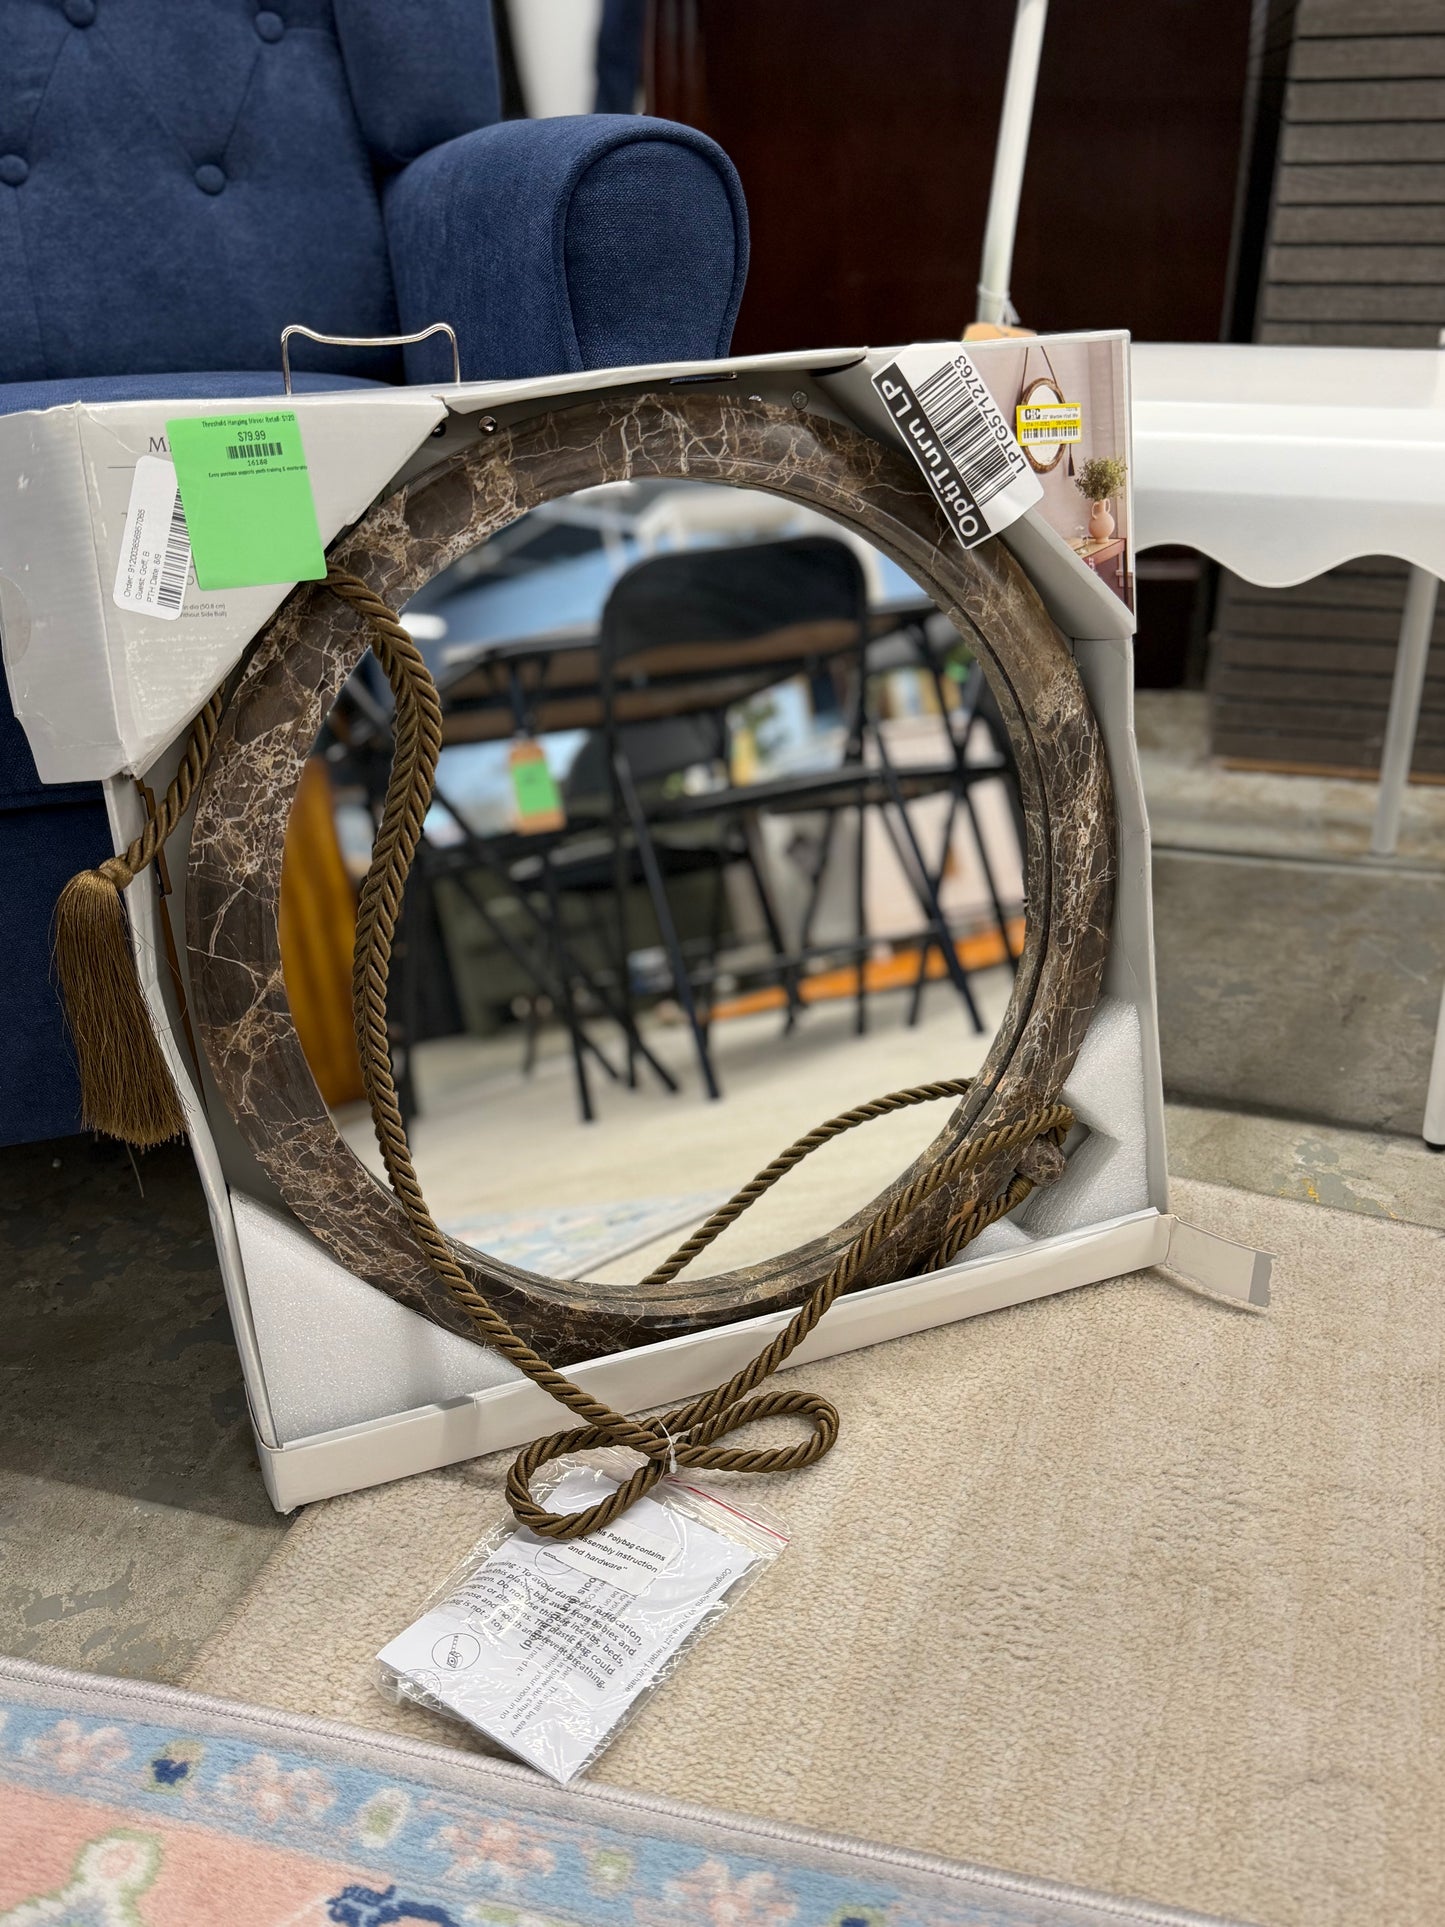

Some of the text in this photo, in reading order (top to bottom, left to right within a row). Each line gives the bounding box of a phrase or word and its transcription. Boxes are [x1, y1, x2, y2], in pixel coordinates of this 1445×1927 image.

[954, 355, 1027, 474] LPTG5712763
[237, 430, 267, 442] $79.99
[881, 380, 979, 537] OptiTurn LP
[568, 1545, 584, 1556] and
[578, 1536, 658, 1573] assembly instruction
[595, 1528, 667, 1562] his Polybag contains
[521, 1568, 532, 1577] To
[532, 1577, 557, 1592] avoid
[470, 1603, 487, 1616] not
[490, 1618, 504, 1631] toy
[481, 1597, 499, 1609] and
[496, 1579, 509, 1589] Do
[602, 1643, 624, 1667] beds,
[534, 1590, 549, 1604] bag
[570, 1608, 591, 1623] from
[591, 1619, 619, 1642] babies
[618, 1639, 637, 1656] and
[575, 1641, 591, 1657] bag
[591, 1654, 615, 1675] could
